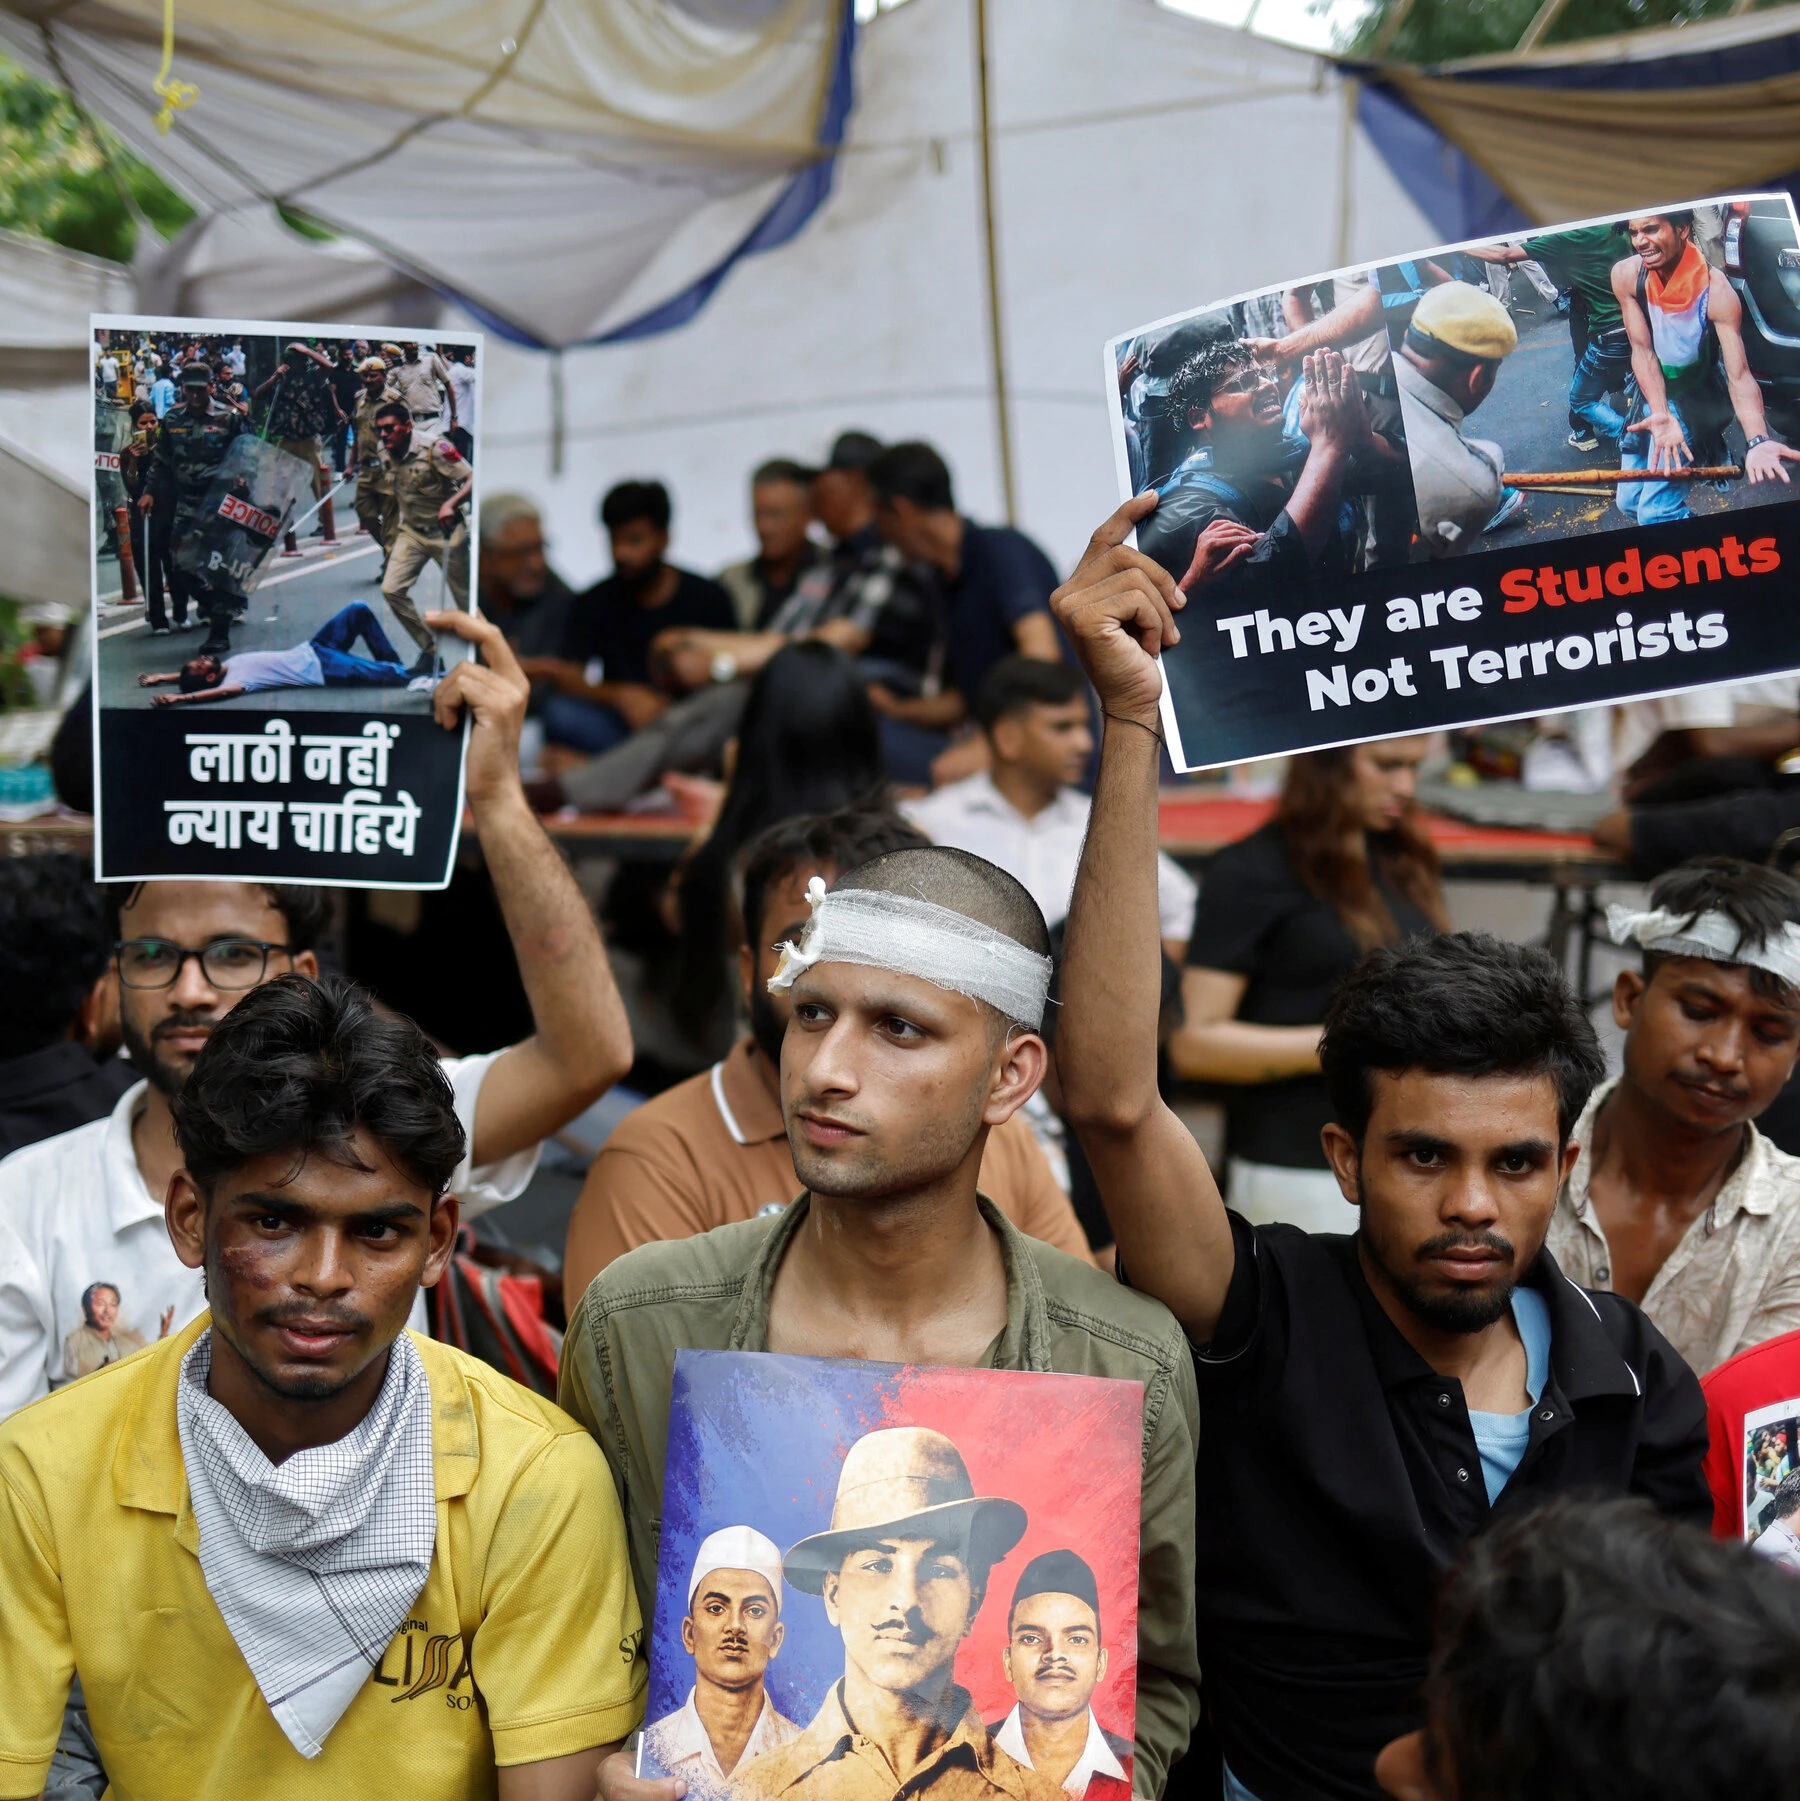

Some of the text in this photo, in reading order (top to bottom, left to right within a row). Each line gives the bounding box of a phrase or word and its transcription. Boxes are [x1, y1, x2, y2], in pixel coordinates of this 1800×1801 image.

[220, 496, 283, 538] POLICE
[1216, 535, 1781, 659] They are Students
[1305, 608, 1729, 712] Not Terrorists
[185, 718, 401, 787] लाठी नहीं
[163, 788, 422, 856] न्याय चाहिये
[397, 1617, 428, 1635] ginal
